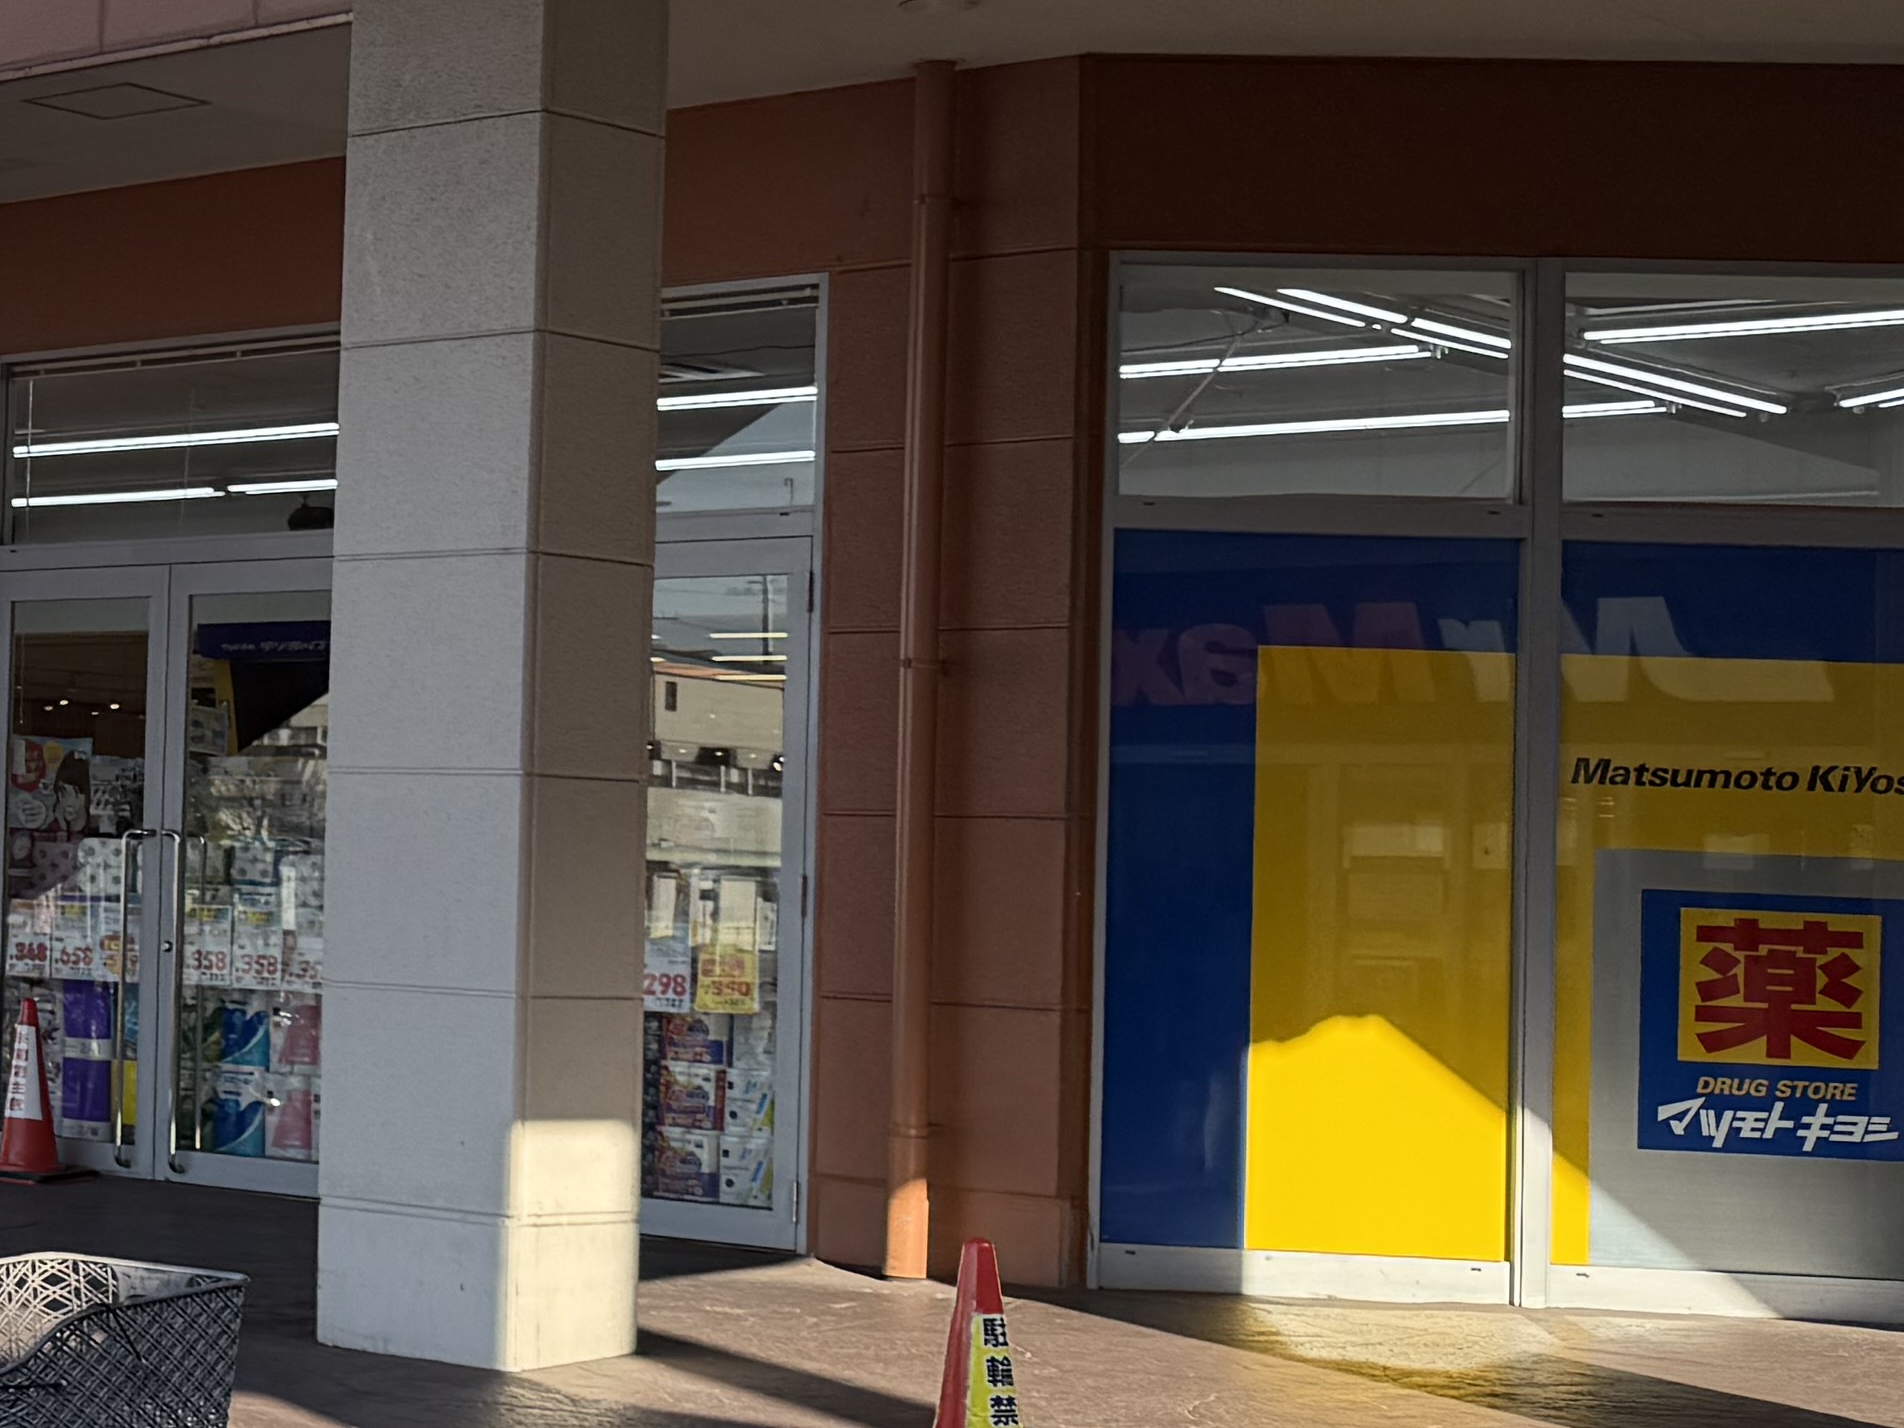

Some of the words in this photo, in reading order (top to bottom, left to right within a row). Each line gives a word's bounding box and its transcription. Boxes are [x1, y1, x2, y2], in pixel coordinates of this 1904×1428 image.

[1571, 757, 1798, 791] Matsumoto
[642, 973, 687, 997] 298
[1695, 918, 1866, 1060] 薬
[1697, 1077, 1768, 1097] DRUG
[1774, 1080, 1858, 1101] STORE
[1657, 1097, 1899, 1152] マツモトキヨシ
